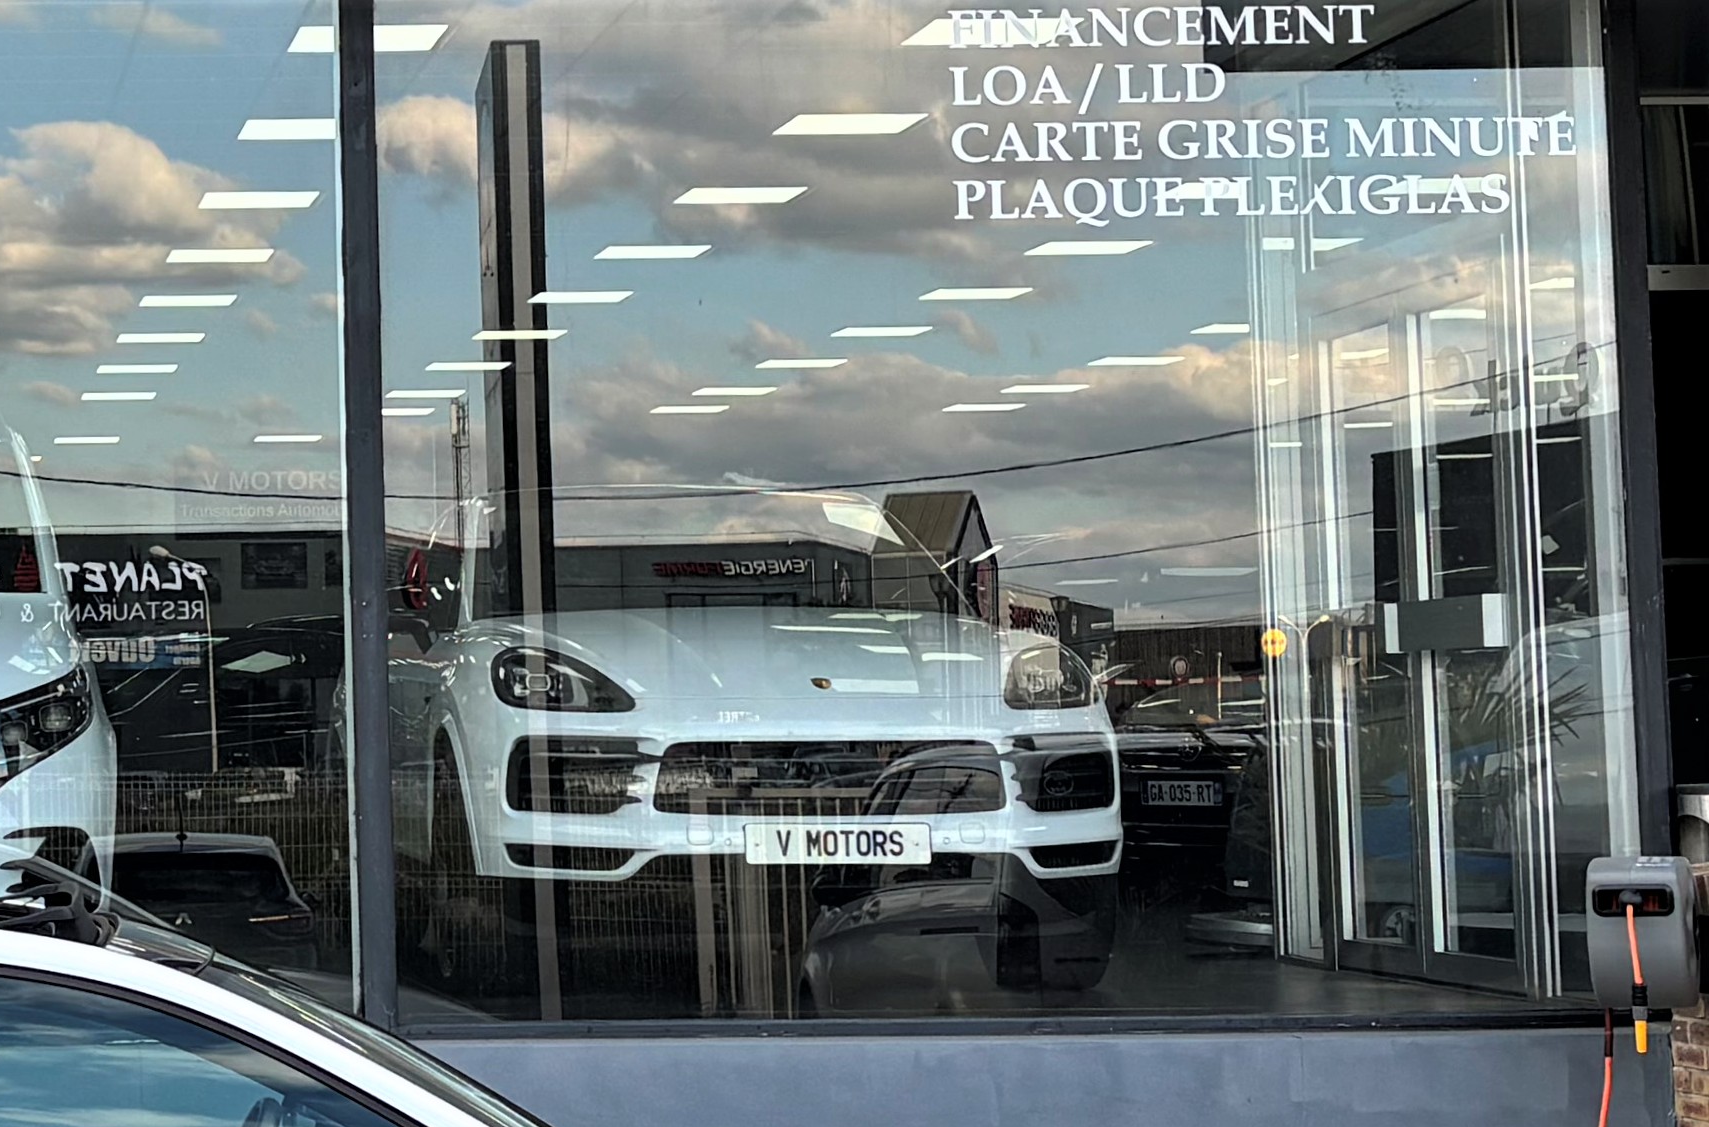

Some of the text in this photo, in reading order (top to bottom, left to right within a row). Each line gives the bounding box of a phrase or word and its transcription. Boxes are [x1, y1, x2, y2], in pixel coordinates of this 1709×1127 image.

[949, 5, 1375, 48] FINANCEMENT
[950, 117, 1577, 163] CARTE GRISE MINUTE
[954, 174, 1511, 227] PLAQUE PLEXIGLAS
[203, 470, 341, 491] V MOTORS
[180, 504, 274, 518] Transactions
[776, 830, 904, 856] V MOTORS
